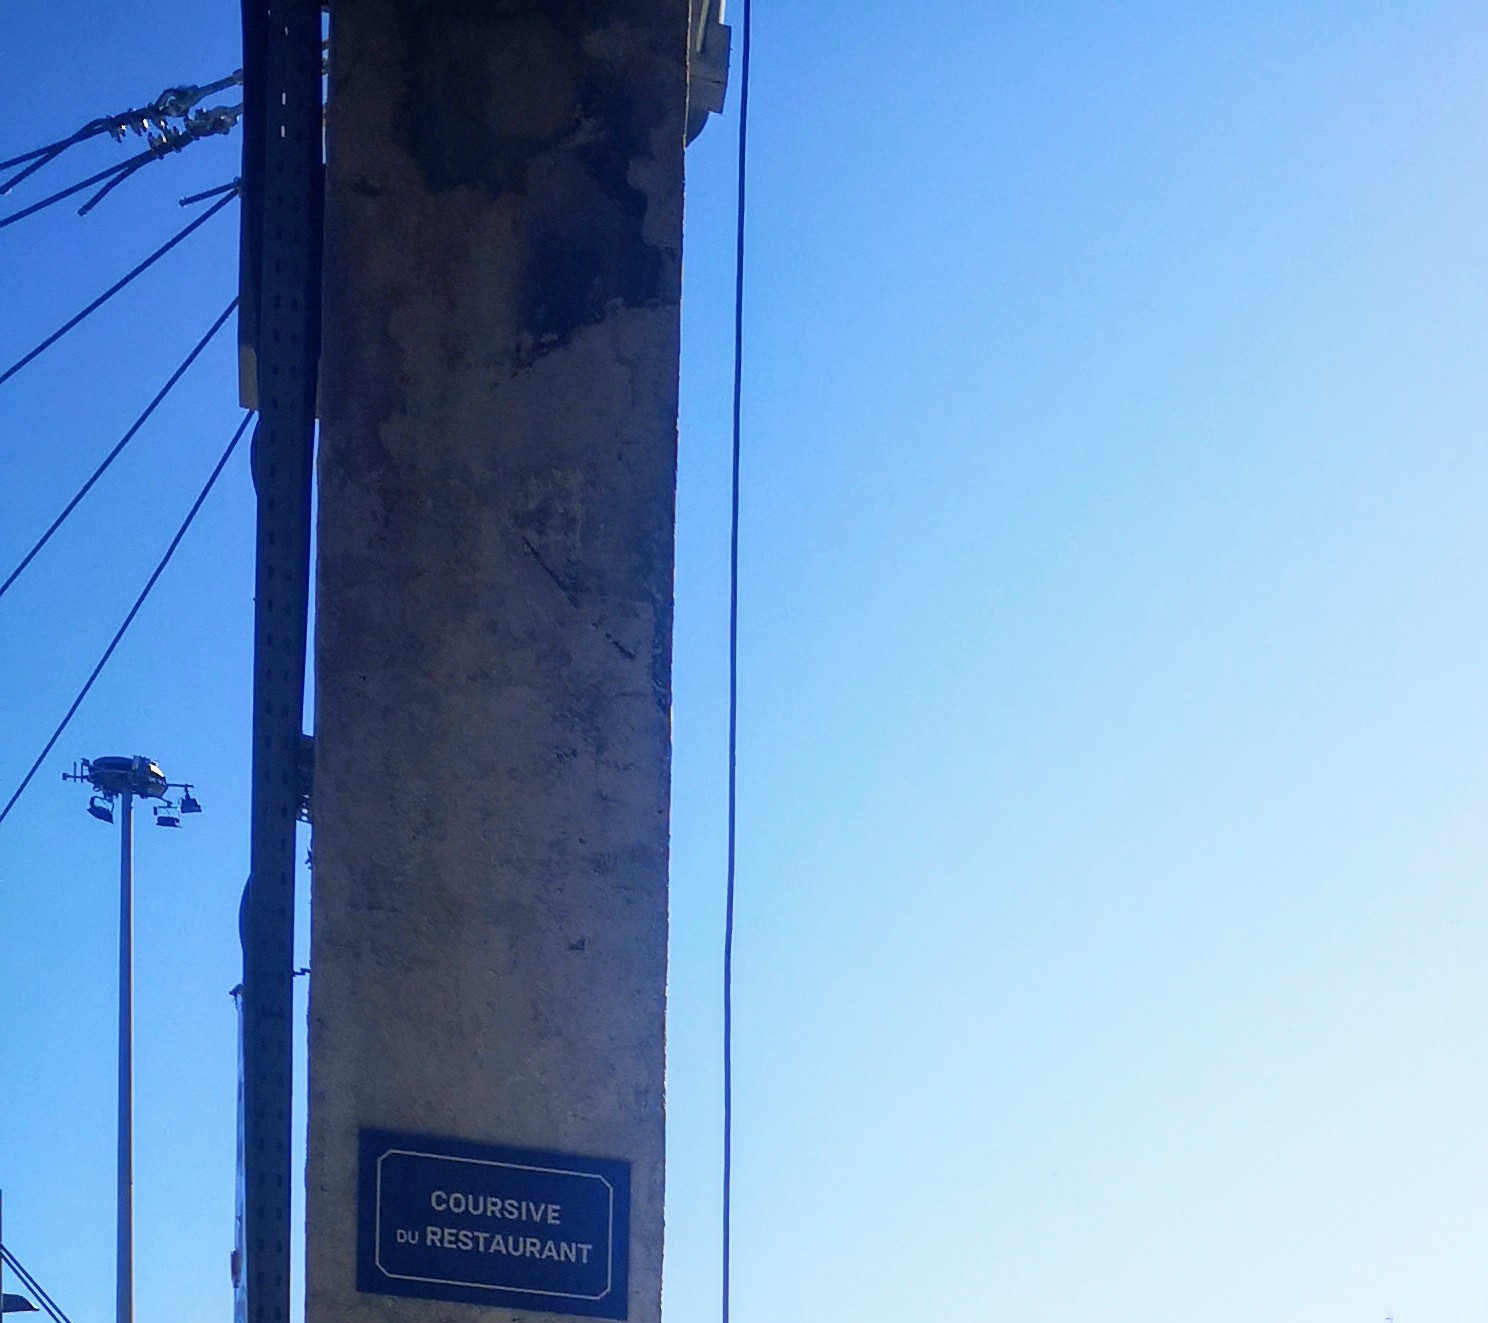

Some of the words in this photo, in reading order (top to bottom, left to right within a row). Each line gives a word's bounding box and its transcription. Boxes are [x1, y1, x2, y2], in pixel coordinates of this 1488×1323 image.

[430, 1190, 561, 1226] COURSIVE
[396, 1229, 419, 1245] DU
[426, 1226, 593, 1265] RESTAURANT
